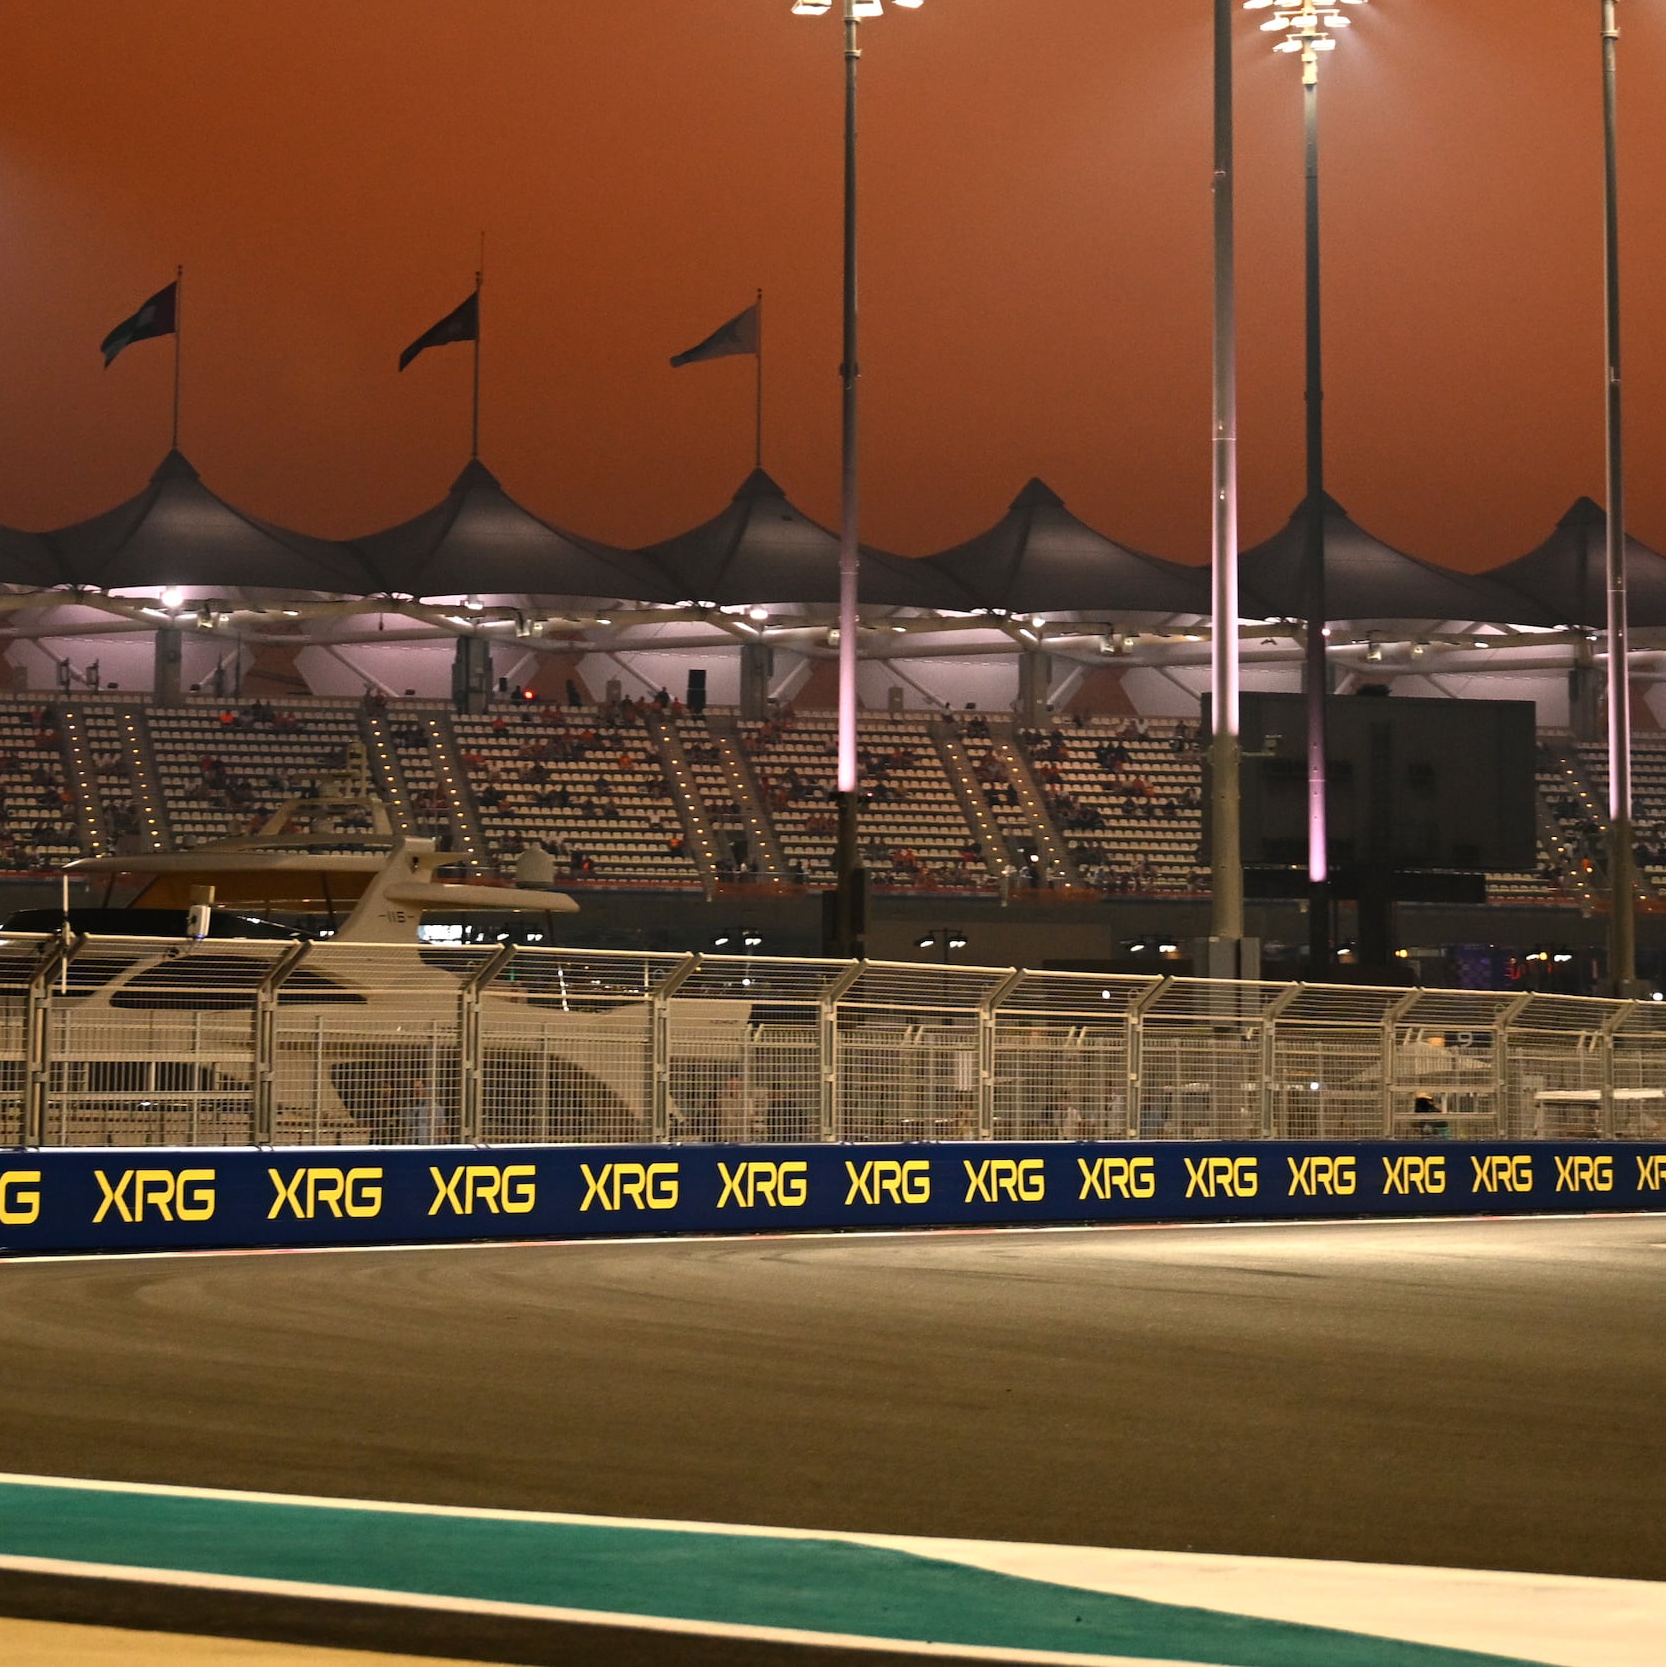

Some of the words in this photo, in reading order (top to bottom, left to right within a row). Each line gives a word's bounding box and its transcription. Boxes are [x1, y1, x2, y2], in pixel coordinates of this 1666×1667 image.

[91, 1168, 217, 1224] XRG
[266, 1166, 385, 1220] XRG
[427, 1164, 538, 1216] XRG
[579, 1162, 681, 1212] XRG
[715, 1161, 809, 1209] XRG
[843, 1159, 932, 1206] XRG
[962, 1158, 1047, 1203] XRG
[1076, 1156, 1157, 1201] XRG
[1183, 1156, 1260, 1199] XRG
[1286, 1155, 1358, 1197] XRG
[1381, 1155, 1448, 1195] XRG
[1469, 1154, 1535, 1193] XRG
[1553, 1155, 1615, 1192] XRG
